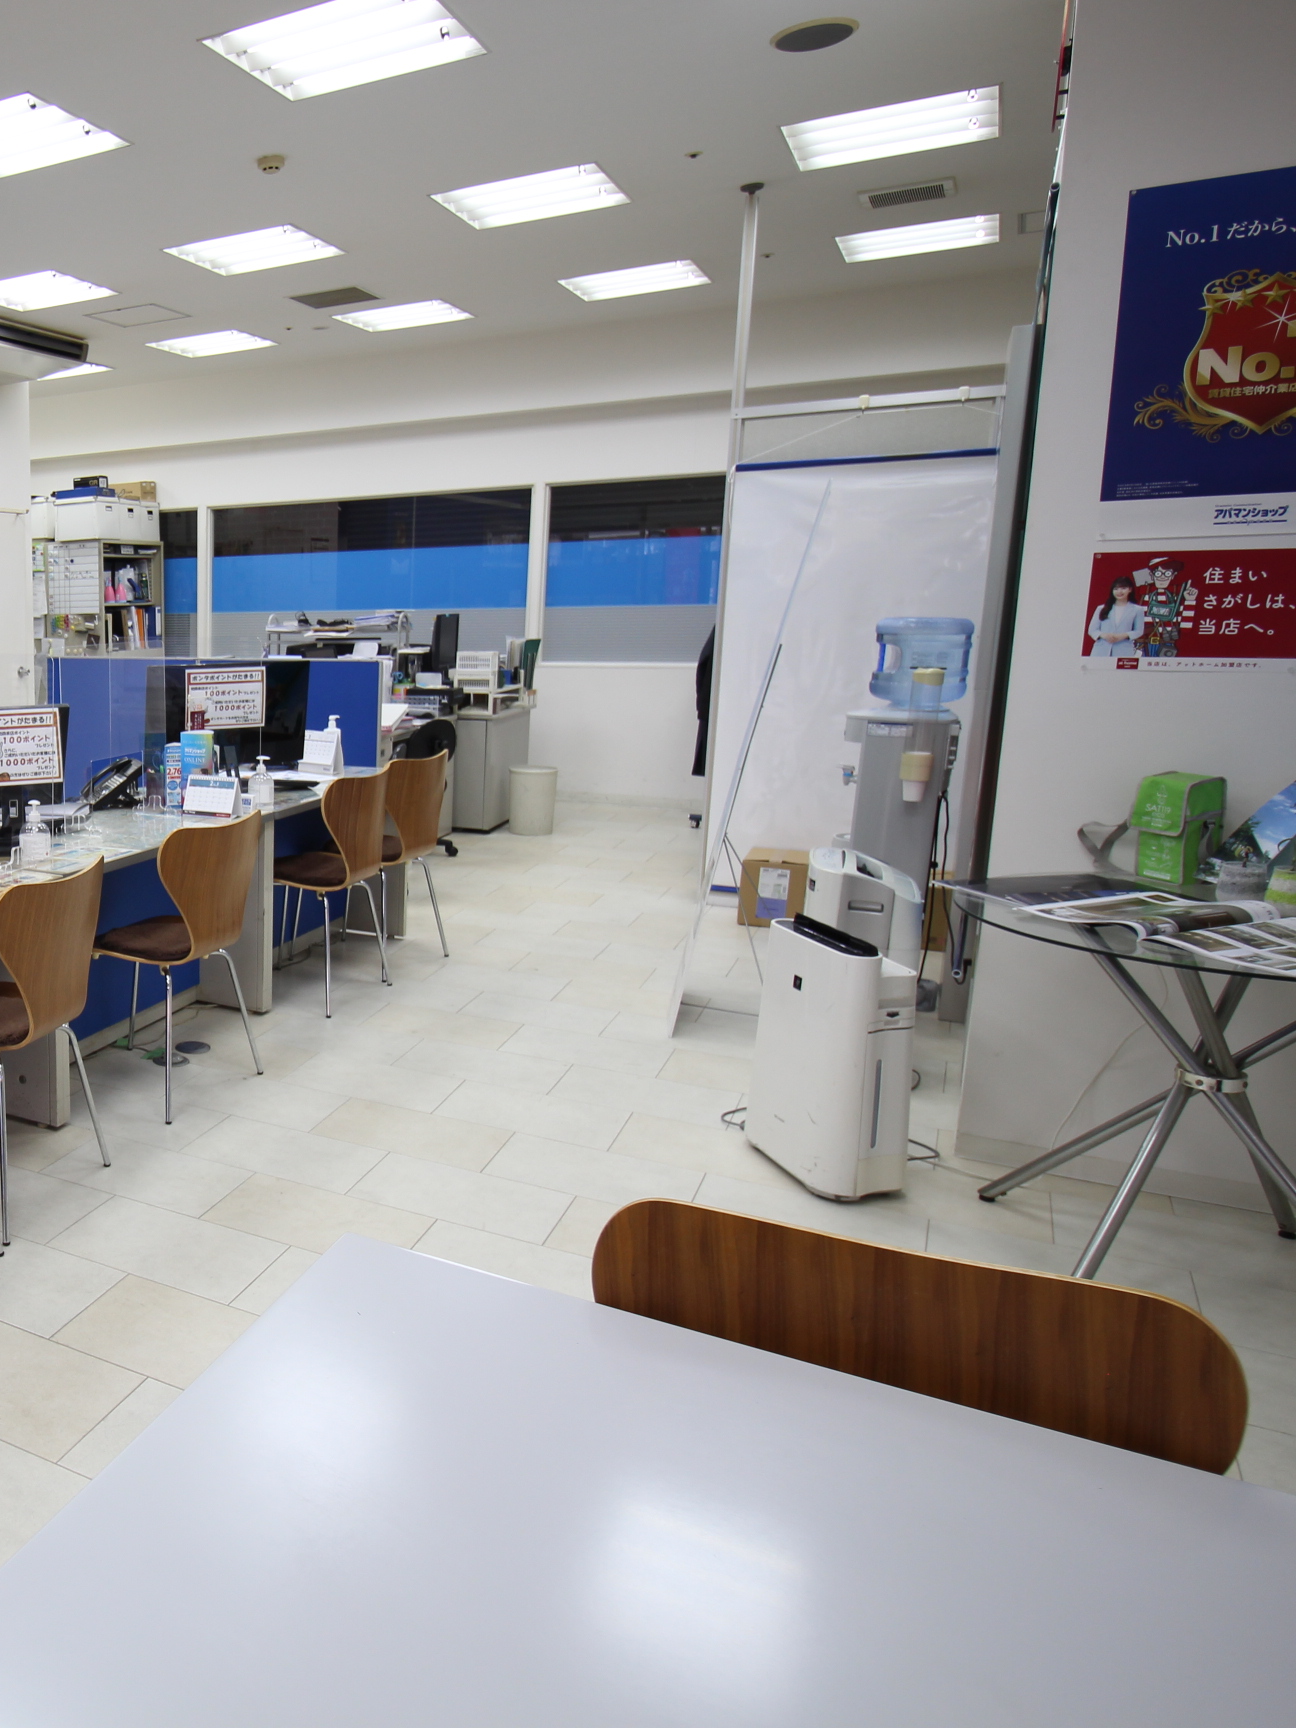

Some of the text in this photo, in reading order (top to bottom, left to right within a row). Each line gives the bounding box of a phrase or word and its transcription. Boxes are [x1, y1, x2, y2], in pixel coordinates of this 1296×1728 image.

[1196, 322, 1296, 386] No.
[1214, 505, 1289, 519] アパマンショップ
[1203, 567, 1267, 585] 住まい
[1203, 594, 1296, 609] さがしは、
[1198, 618, 1275, 635] 当店へ。
